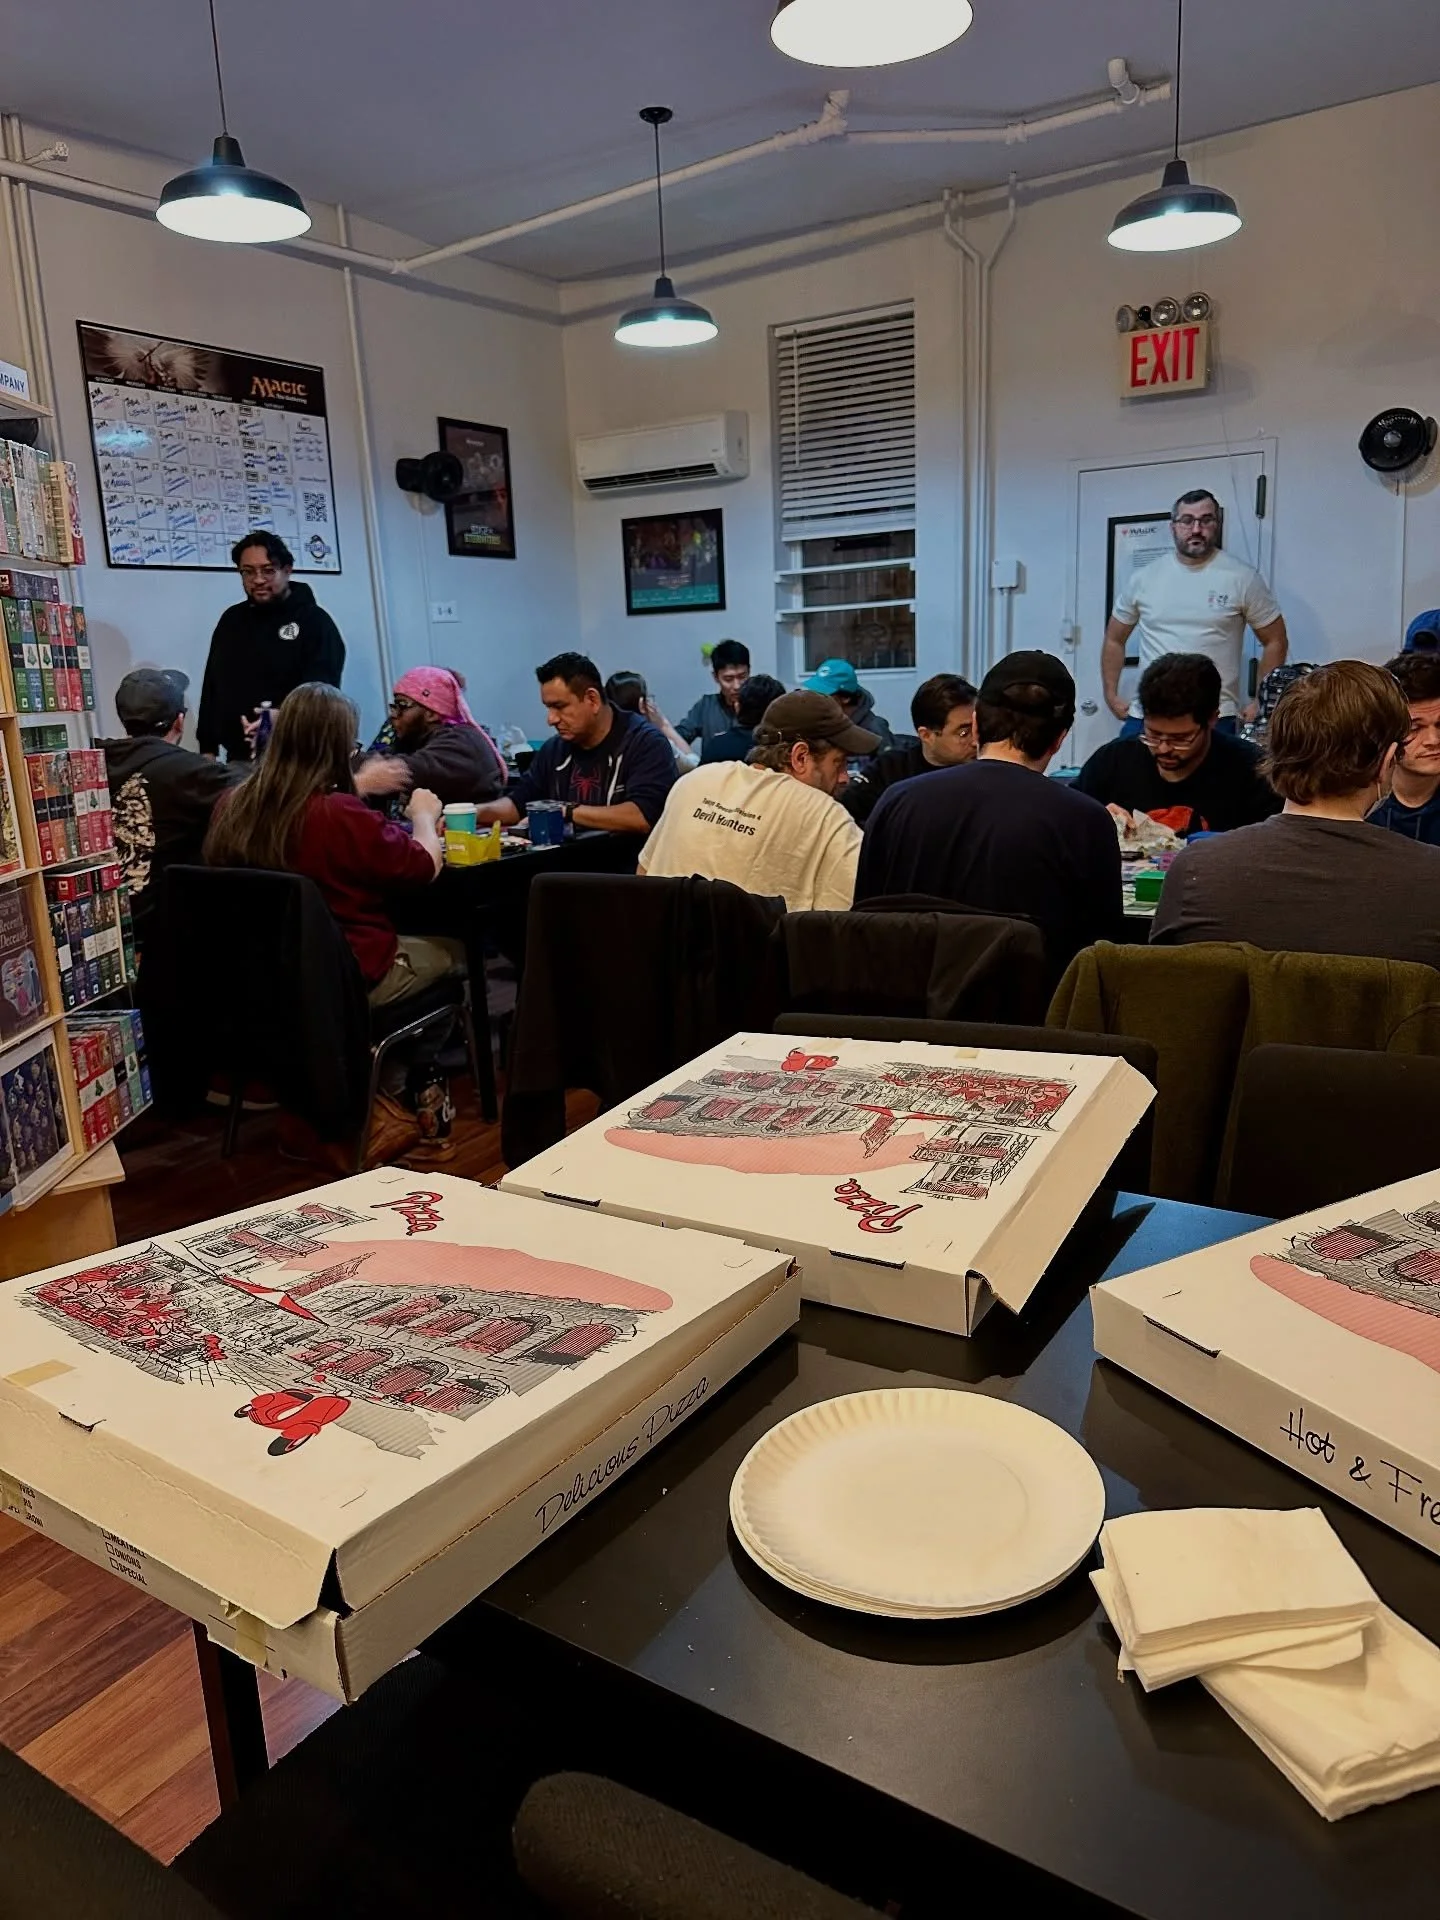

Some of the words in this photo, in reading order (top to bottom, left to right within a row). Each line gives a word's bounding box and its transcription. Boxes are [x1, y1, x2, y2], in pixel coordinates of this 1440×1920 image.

[1130, 327, 1200, 388] EXIT
[250, 376, 309, 398] MAGIC
[692, 808, 716, 823] Devil
[716, 814, 756, 836] Hunters
[370, 1191, 444, 1236] Pizza
[834, 1178, 923, 1233] Pizza
[534, 1436, 639, 1533] Delicious
[641, 1377, 709, 1443] Pizza
[1279, 1407, 1335, 1464] Hot
[1349, 1456, 1373, 1490] &
[114, 1547, 142, 1570] ONIONS
[118, 1562, 148, 1586] SPECIAL
